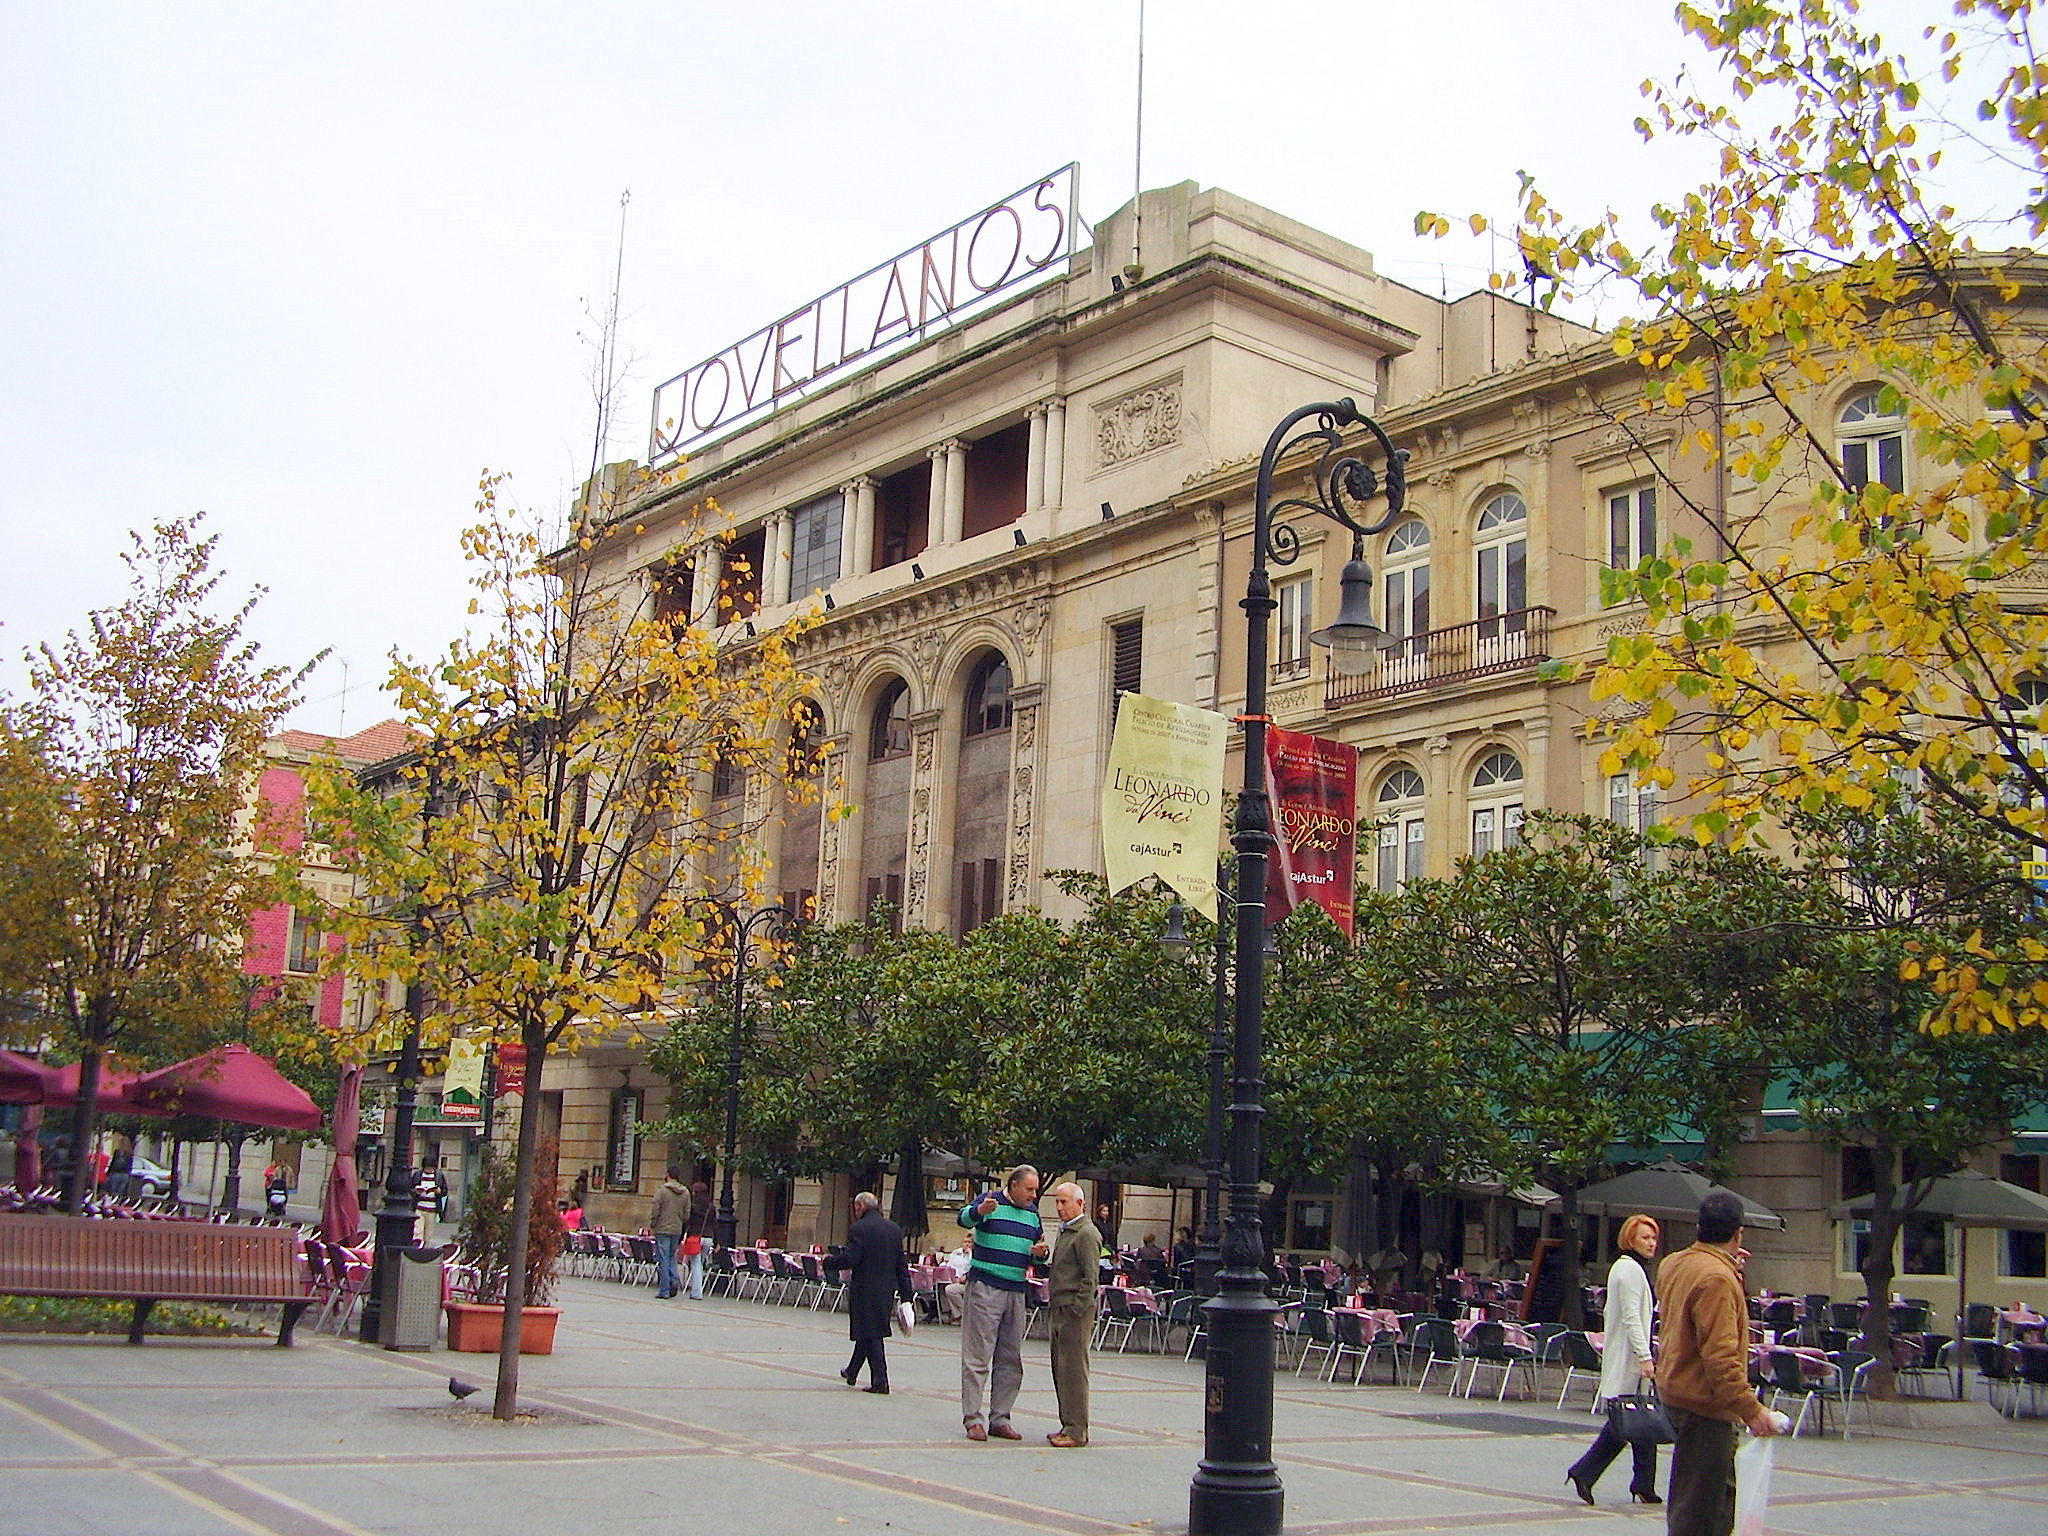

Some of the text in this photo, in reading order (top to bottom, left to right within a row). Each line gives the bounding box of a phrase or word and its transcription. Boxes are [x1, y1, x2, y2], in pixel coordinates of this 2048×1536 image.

[655, 179, 1064, 451] JOVELLANOS
[1114, 768, 1209, 806] LEONARDO
[1138, 792, 1193, 824] Vinci
[1271, 799, 1352, 835] LEONARDO
[1130, 843, 1172, 857] cajAstur
[1292, 822, 1339, 853] Vinci
[1290, 872, 1327, 884] cajAstur
